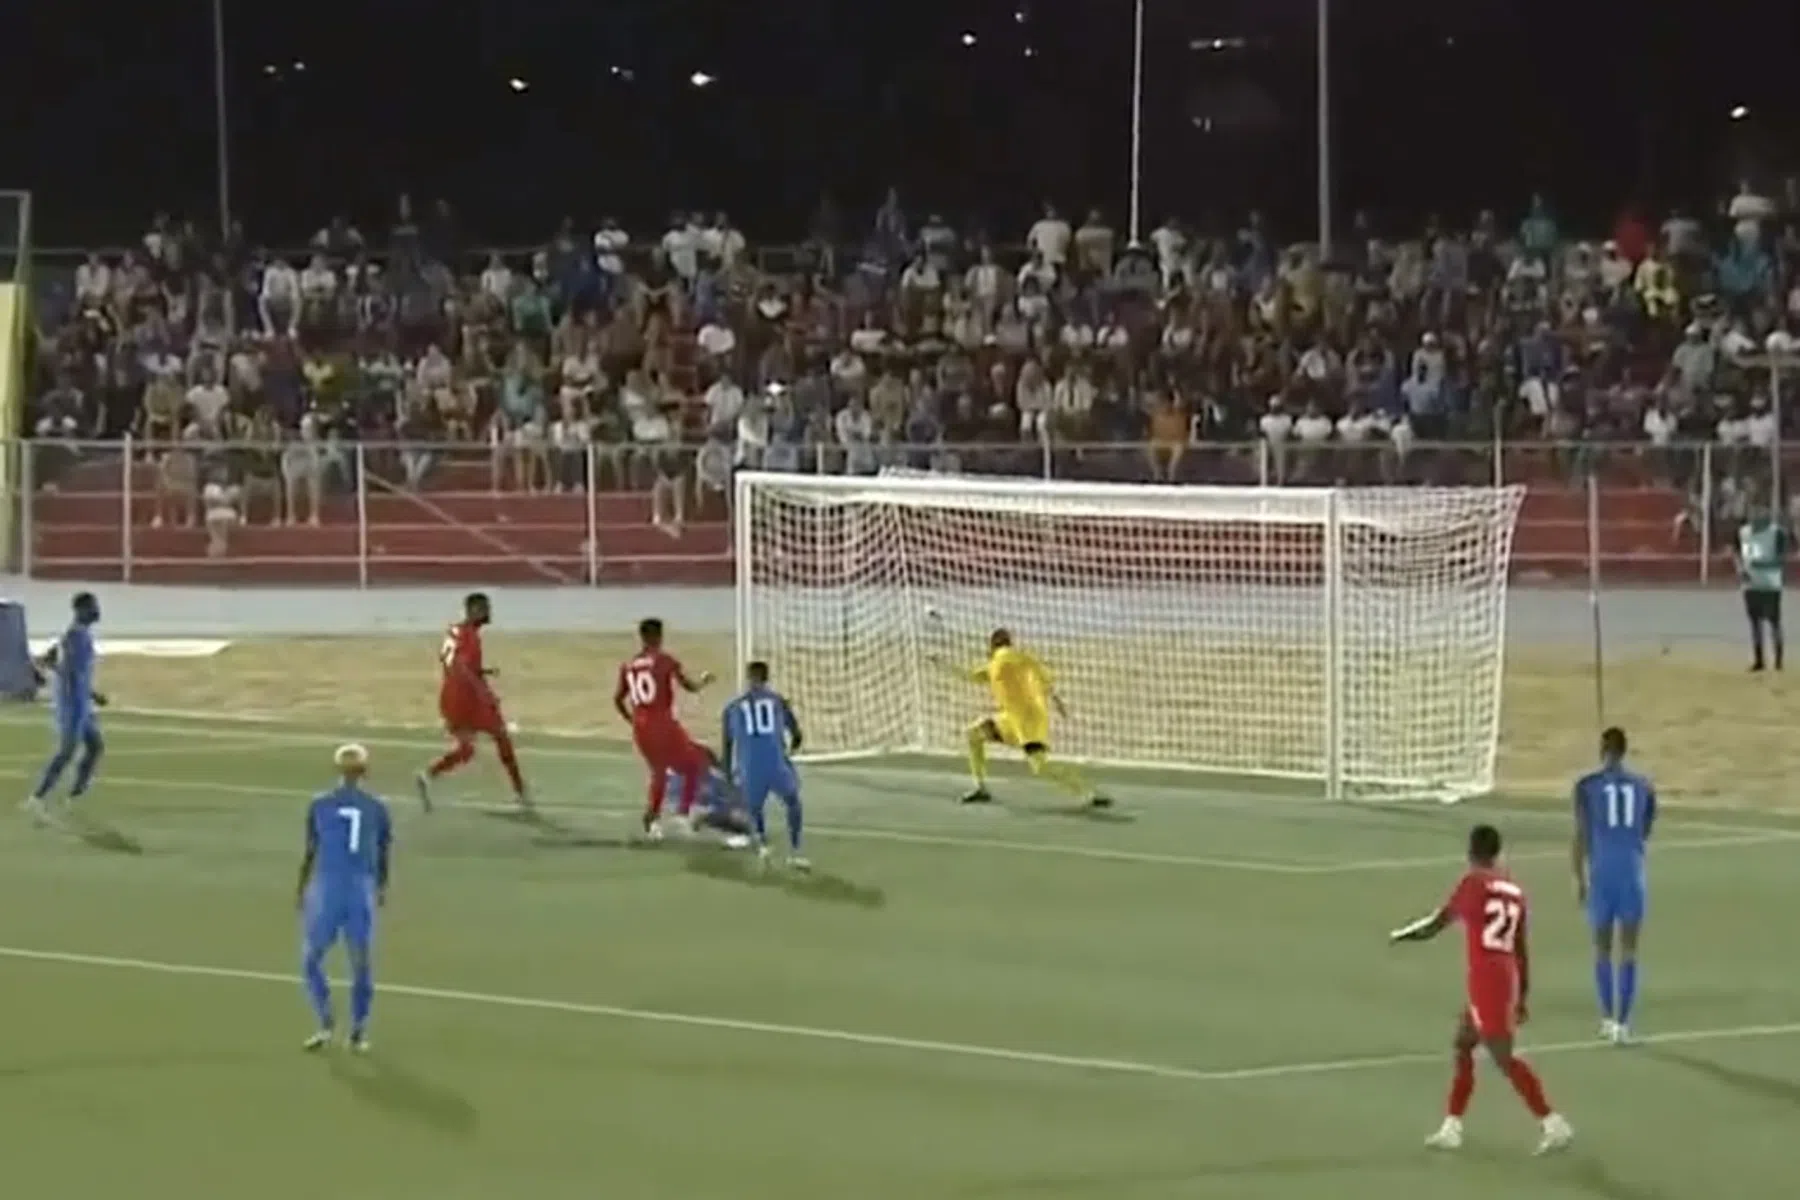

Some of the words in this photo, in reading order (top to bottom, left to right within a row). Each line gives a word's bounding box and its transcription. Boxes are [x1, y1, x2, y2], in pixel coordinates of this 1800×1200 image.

[627, 670, 656, 705] 10
[740, 699, 774, 735] 10
[1603, 783, 1634, 828] 11
[338, 807, 361, 852] 7
